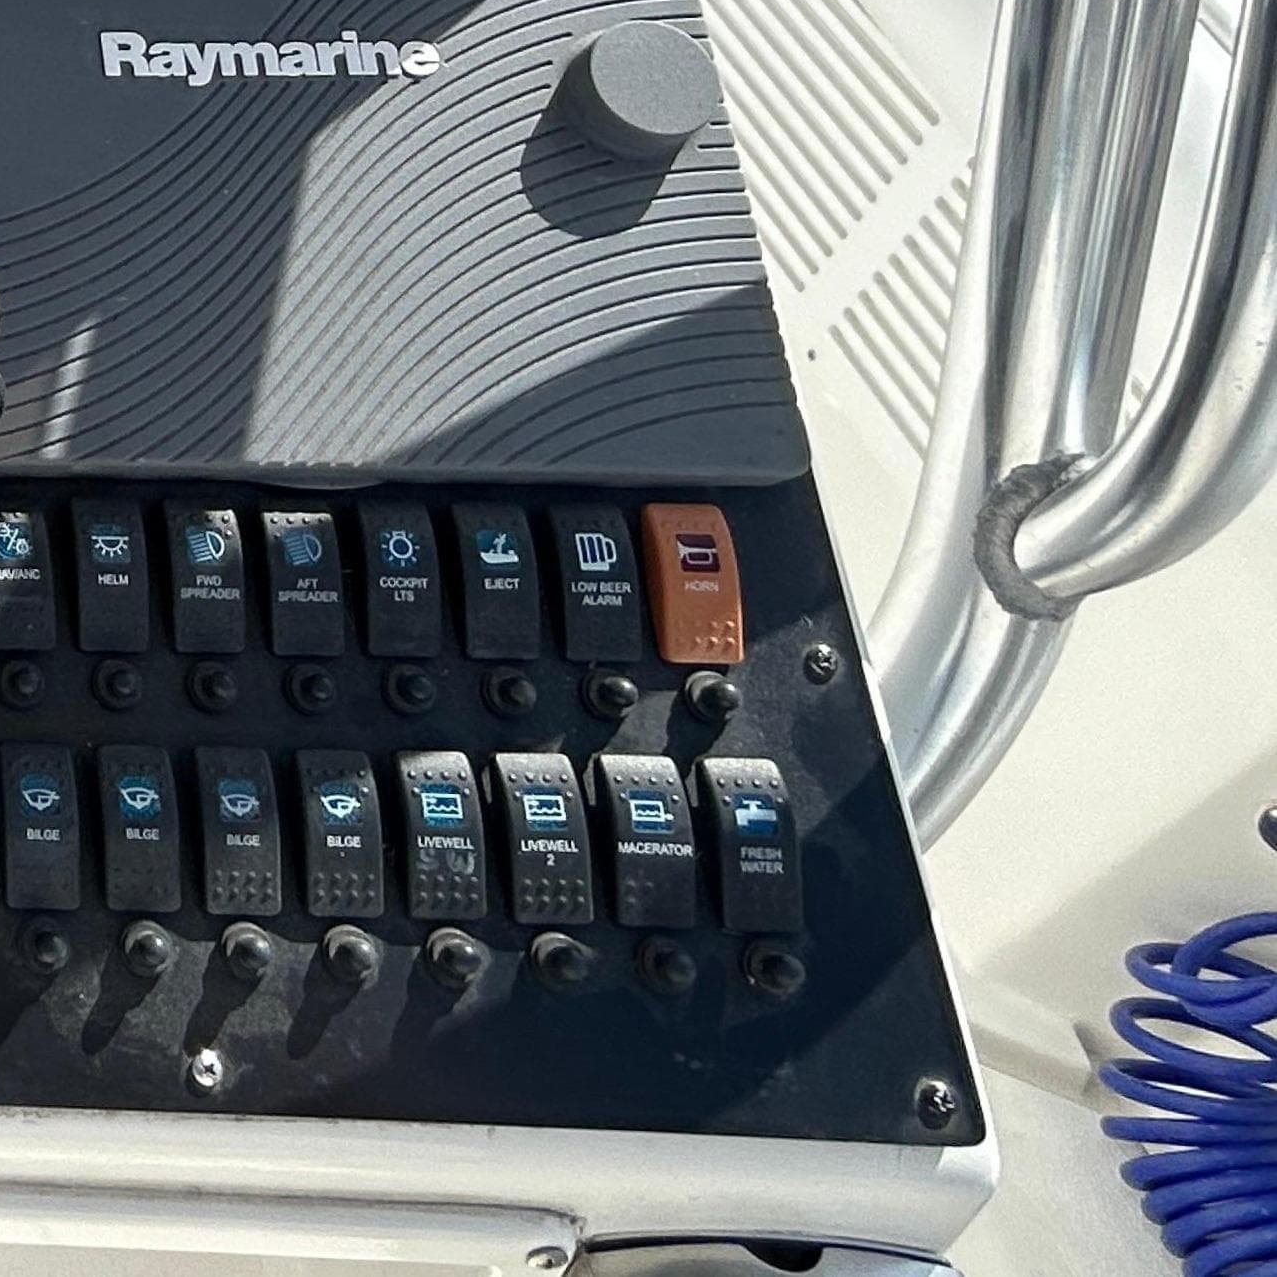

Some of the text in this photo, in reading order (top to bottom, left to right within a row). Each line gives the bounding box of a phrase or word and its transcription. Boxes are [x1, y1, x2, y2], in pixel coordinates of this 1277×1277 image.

[99, 30, 441, 87] Raymarine
[97, 574, 129, 586] HELM
[196, 575, 222, 587] FWD
[296, 578, 319, 590] AFT
[379, 576, 429, 590] COCKPIT
[484, 578, 521, 590] EJECT
[684, 580, 720, 592] HORN
[180, 587, 241, 601] SPREADER
[571, 581, 632, 594] LOW BEER
[278, 590, 339, 603] SPREADER
[393, 590, 415, 603] LTS
[582, 594, 623, 607] ALARM
[26, 828, 60, 841] BILGE
[125, 827, 160, 841] BILGE
[226, 833, 261, 847] BILGE
[326, 835, 362, 848] BILGE
[417, 835, 475, 850] LIVEWELL
[521, 839, 579, 853] LIVEWELL
[617, 841, 694, 857] MACERATOR
[740, 846, 782, 860] FRESH
[546, 853, 556, 866] 2
[739, 860, 785, 874] WATER
